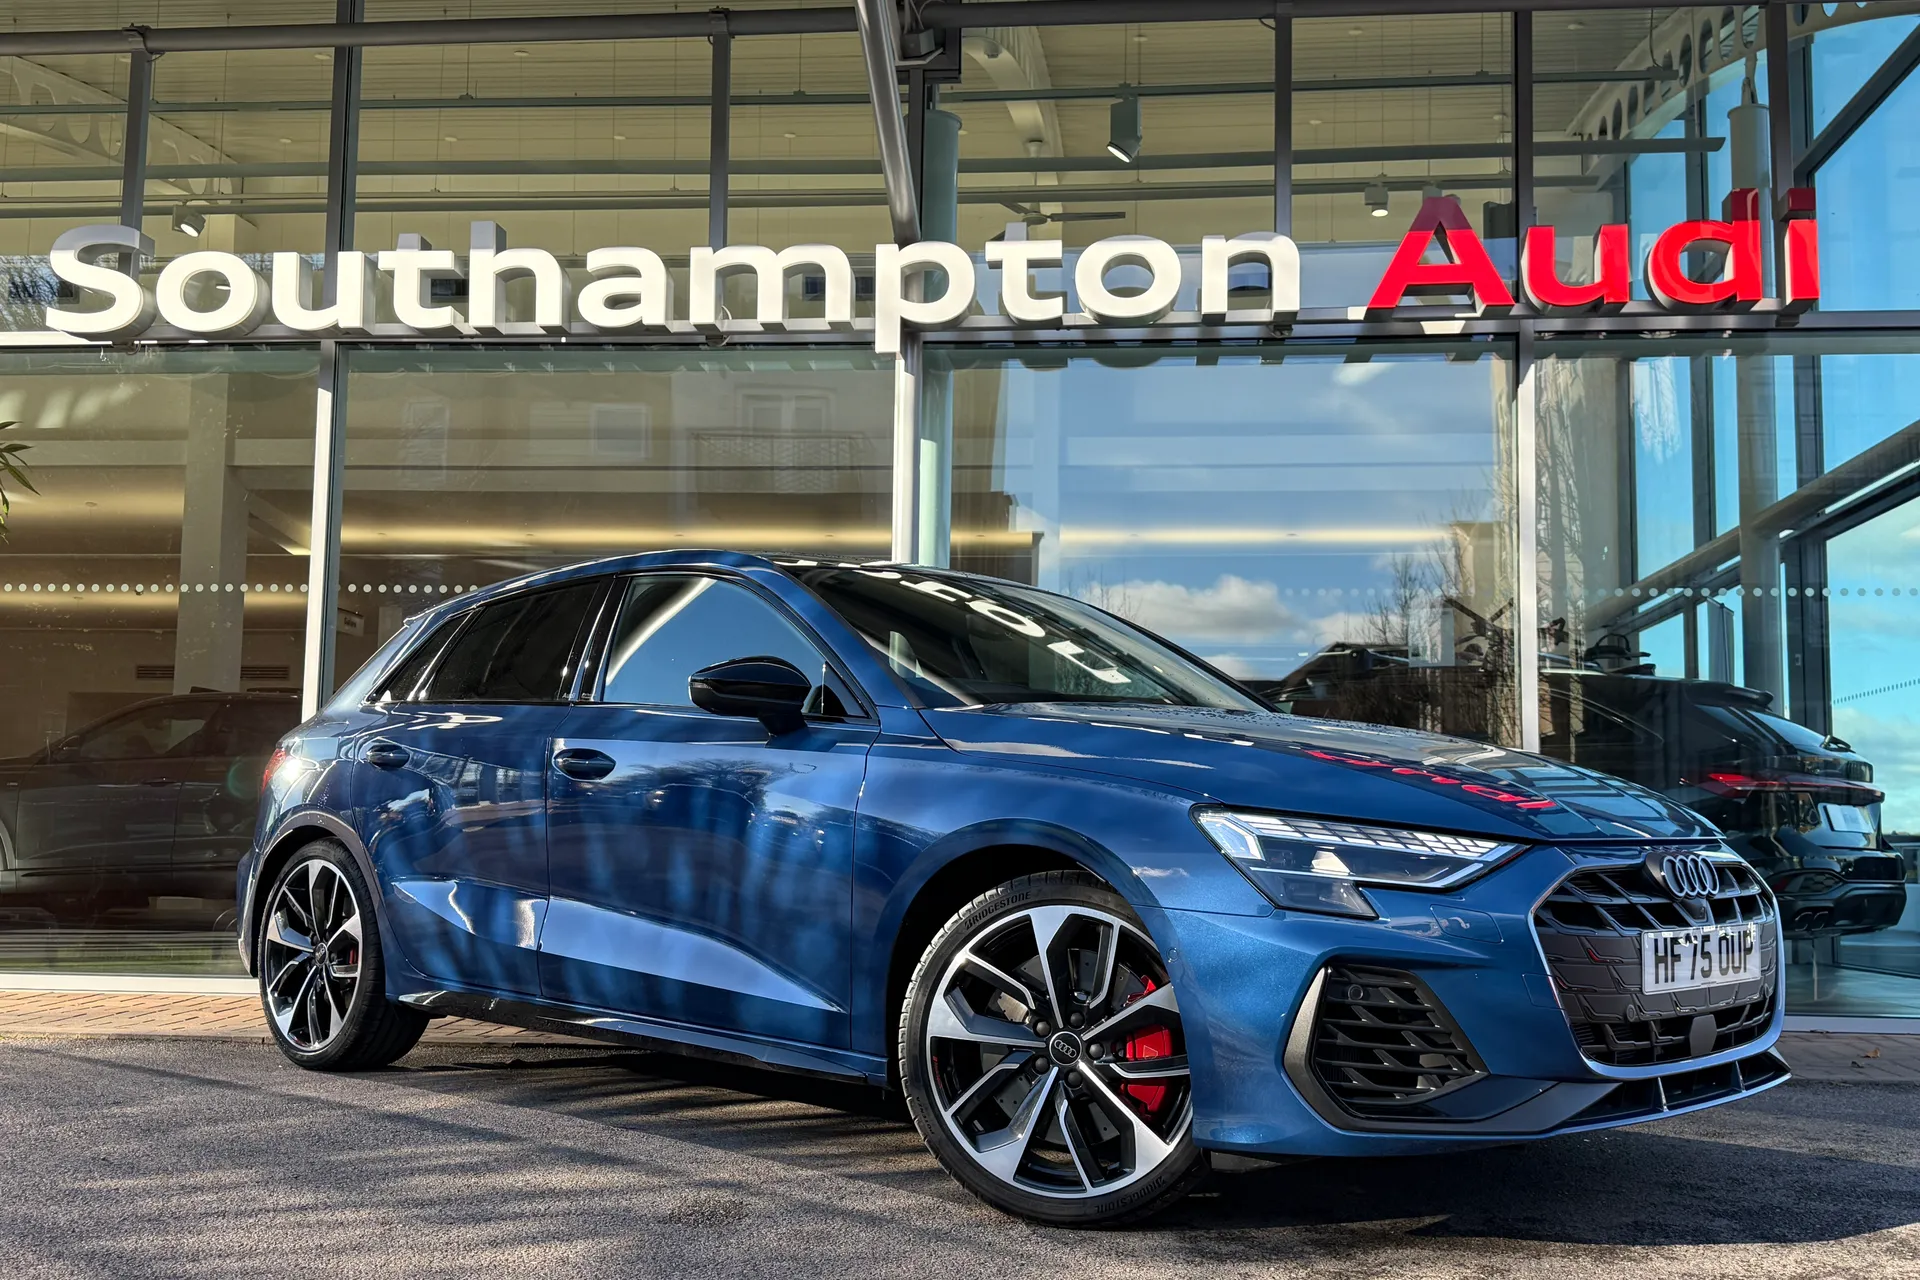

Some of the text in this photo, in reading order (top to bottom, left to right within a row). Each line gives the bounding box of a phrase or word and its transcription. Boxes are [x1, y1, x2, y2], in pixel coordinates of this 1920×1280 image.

[45, 188, 1820, 354] Southampton Audi
[964, 891, 1031, 931] BRIDGESTONE
[916, 1096, 935, 1135] POTENZA
[1095, 1176, 1165, 1214] BRIDGESTONE
